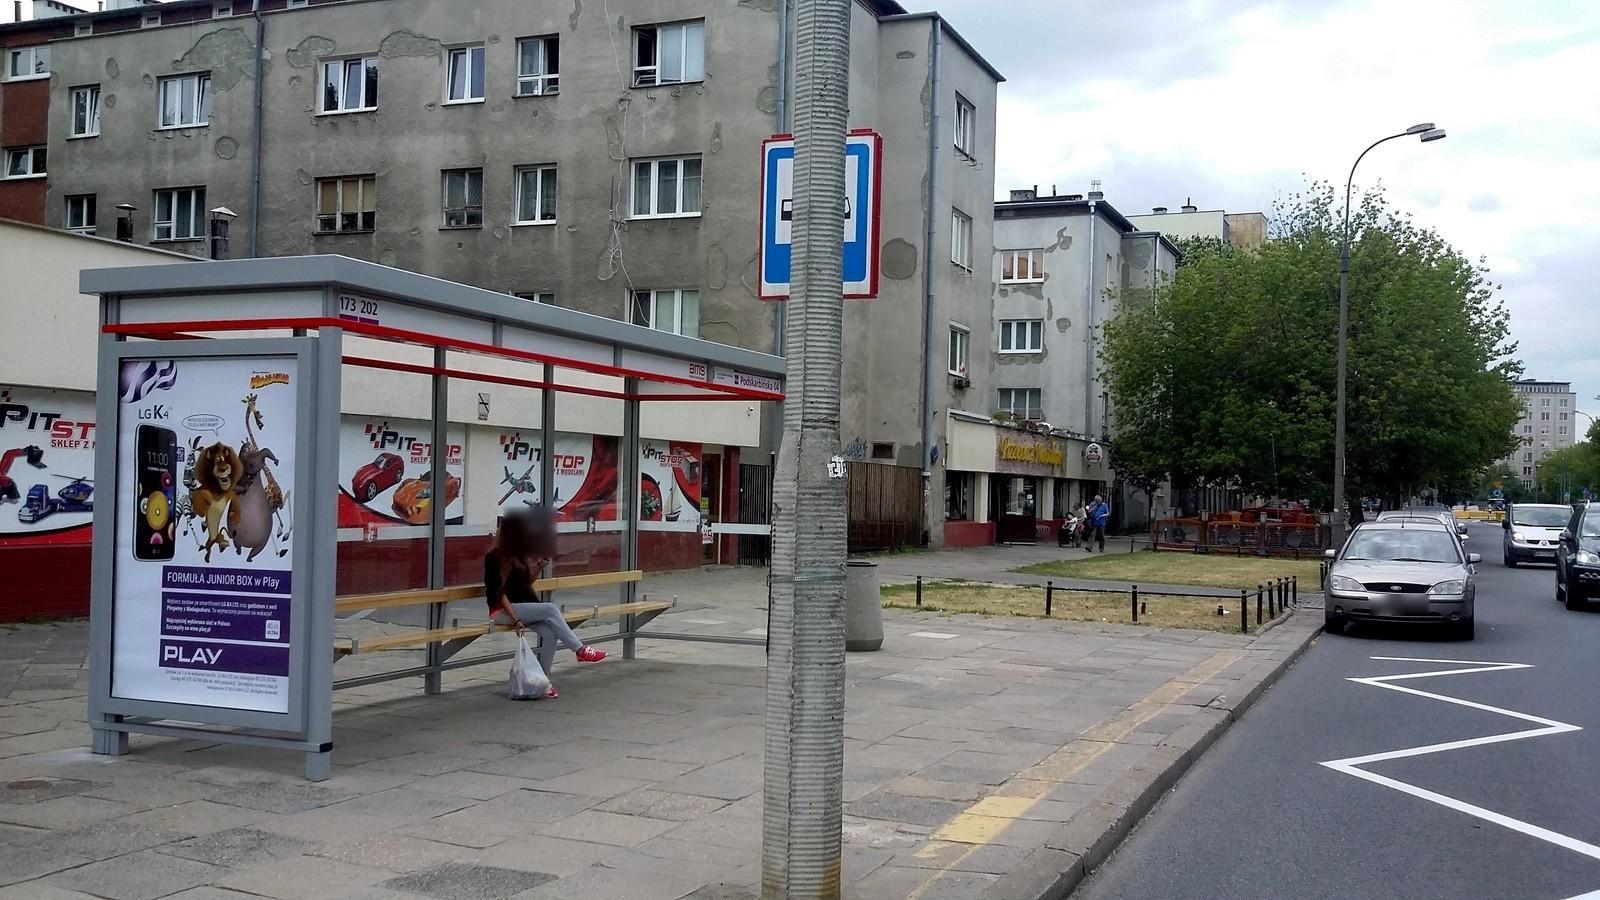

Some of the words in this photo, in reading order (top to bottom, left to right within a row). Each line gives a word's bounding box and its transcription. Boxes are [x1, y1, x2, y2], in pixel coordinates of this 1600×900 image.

[340, 296, 356, 312] 173
[361, 300, 378, 316] 202
[689, 363, 706, 377] ams
[138, 409, 152, 420] LG
[153, 404, 169, 420] K4
[51, 439, 80, 449] SKLEP
[83, 440, 89, 449] Z
[167, 572, 205, 584] FORMUŁA
[206, 574, 236, 585] JUNIOR
[236, 575, 253, 586] BOX
[254, 578, 261, 586] w
[262, 576, 280, 590] Play
[164, 645, 223, 665] PLAY
